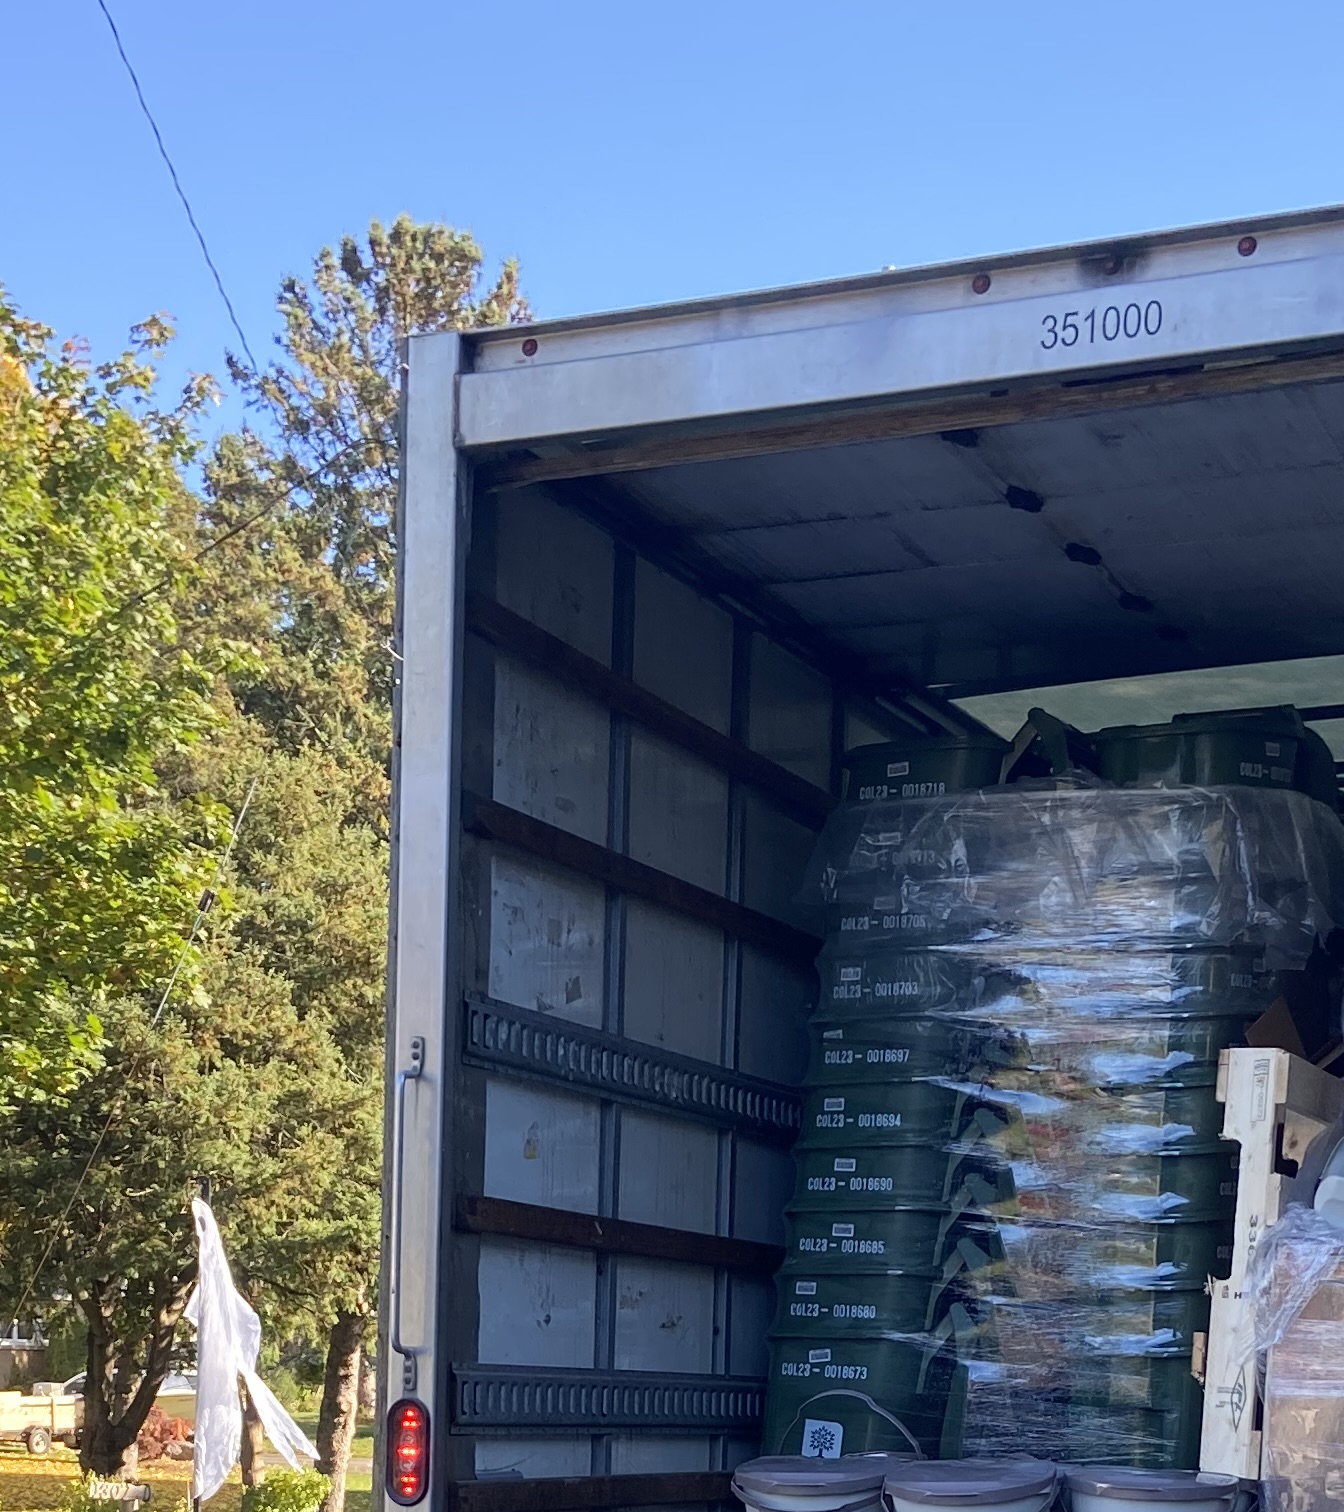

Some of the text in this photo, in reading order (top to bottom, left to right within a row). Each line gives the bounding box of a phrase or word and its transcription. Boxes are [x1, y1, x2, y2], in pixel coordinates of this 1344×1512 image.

[1040, 300, 1163, 350] 351000
[858, 1113, 902, 1127] 0018694
[849, 1177, 893, 1191] 0018690
[833, 1304, 876, 1318] 0018680
[824, 1364, 868, 1380] 0018673
